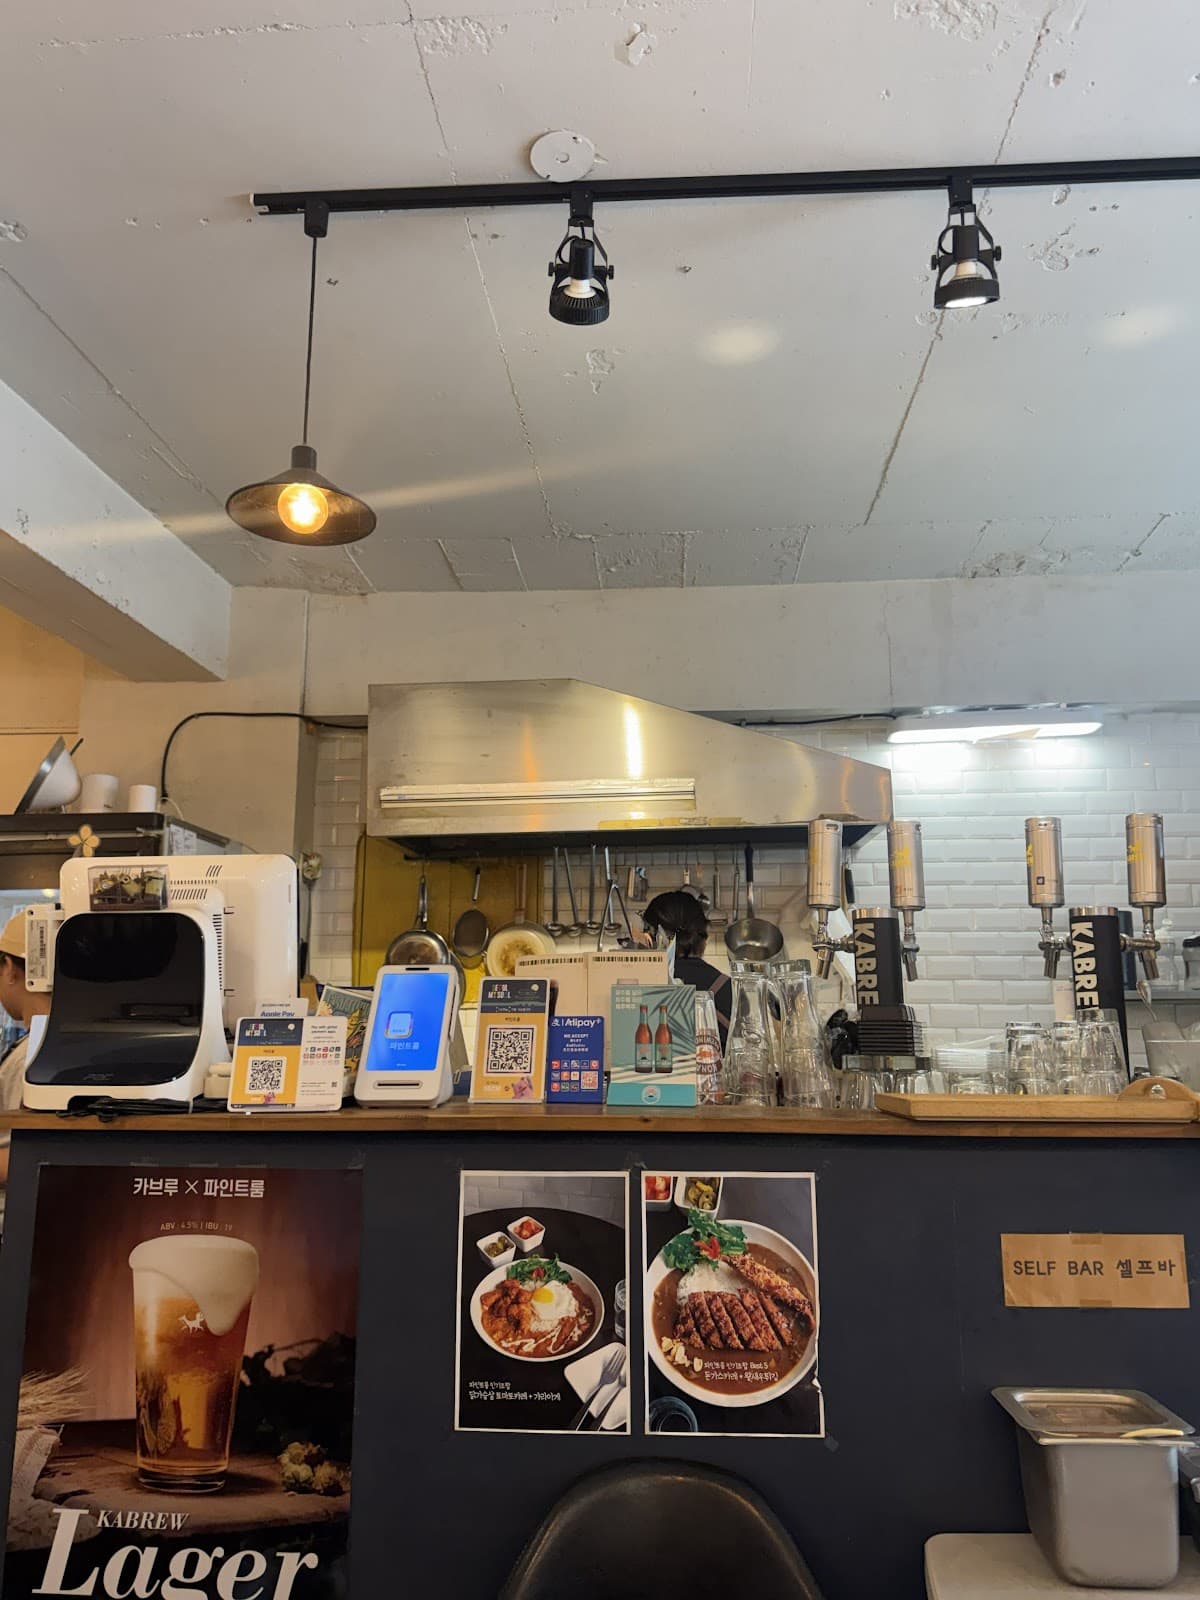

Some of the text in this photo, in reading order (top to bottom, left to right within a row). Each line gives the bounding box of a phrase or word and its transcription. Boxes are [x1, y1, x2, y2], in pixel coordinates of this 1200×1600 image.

[853, 922, 880, 1006] KABRE
[1071, 921, 1100, 1010] KABRE
[133, 1178, 179, 1197] 카브루
[203, 1179, 265, 1198] 파인트룸
[1013, 1258, 1176, 1279] SELF BAR 셀프바
[96, 1509, 190, 1531] KABREW
[31, 1507, 319, 1600] Lager
